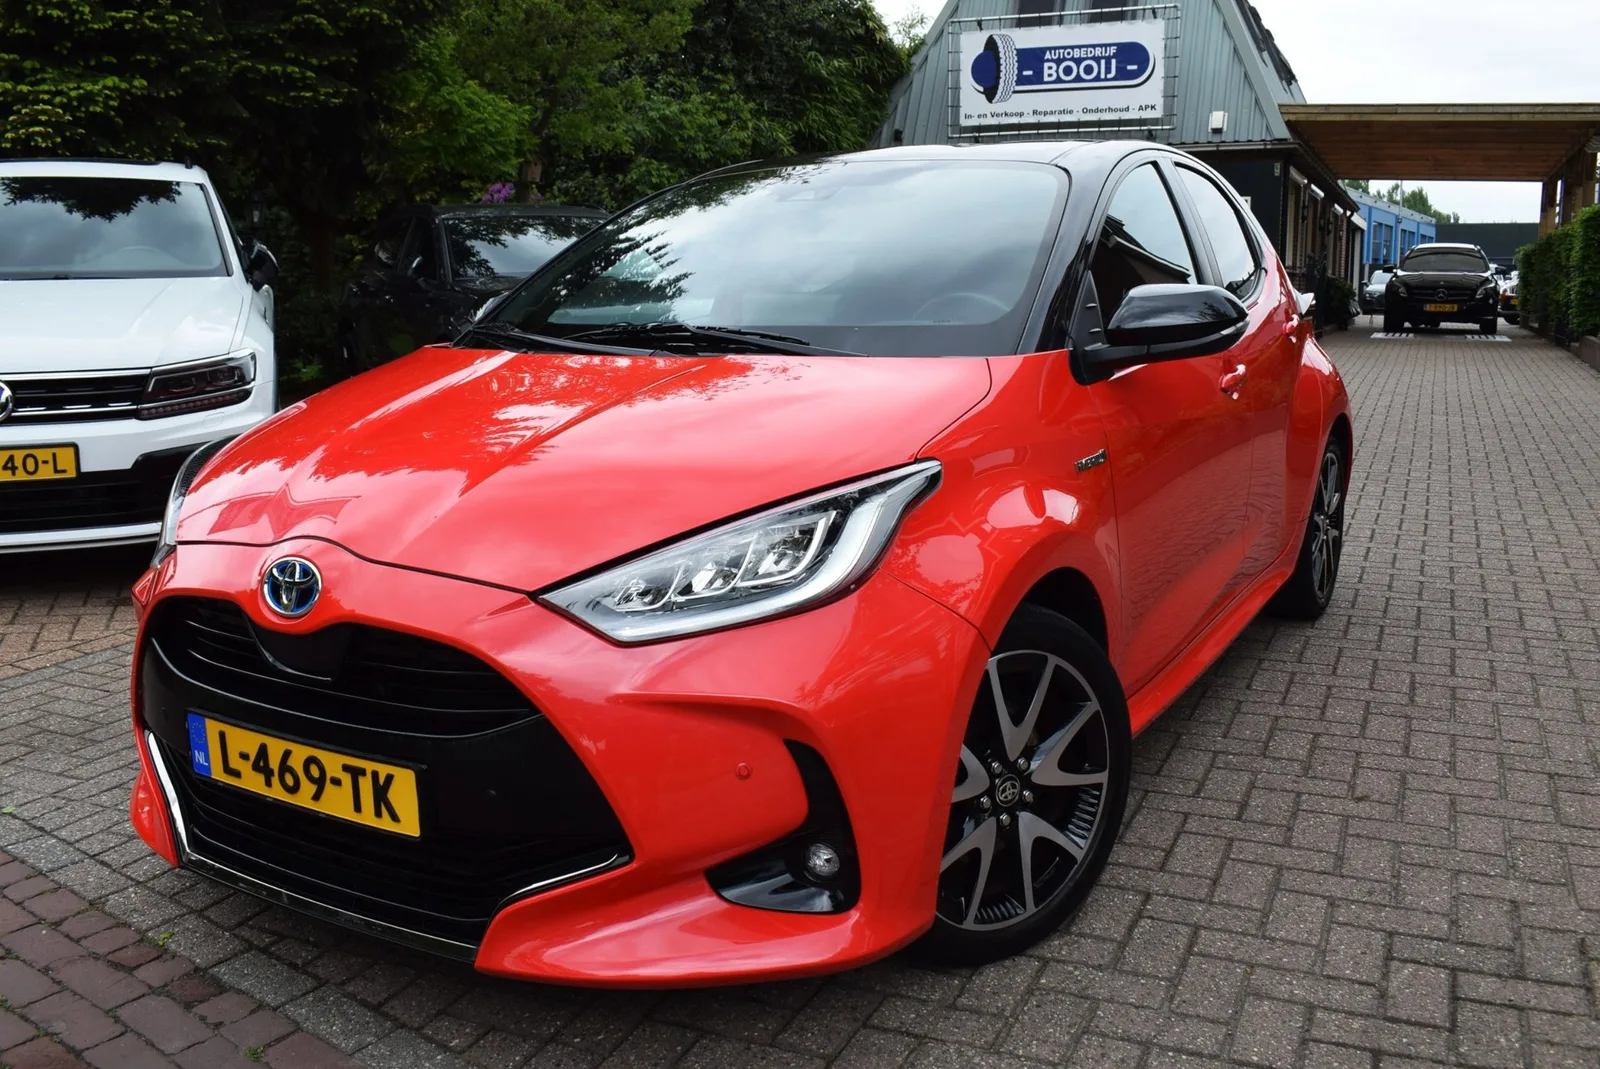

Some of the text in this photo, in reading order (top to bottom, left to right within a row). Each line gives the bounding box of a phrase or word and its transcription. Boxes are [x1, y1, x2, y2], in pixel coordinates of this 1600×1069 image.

[1044, 46, 1117, 60] AUTOBEDRIJF
[1043, 58, 1116, 82] BOOIJ
[964, 112, 975, 120] In-
[990, 110, 1025, 118] Verkoop
[1032, 108, 1074, 117] Reparatie
[1081, 105, 1130, 115] Onderhoud
[1137, 103, 1157, 112] APK
[1, 452, 68, 476] 40-L
[194, 749, 209, 766] NL
[218, 730, 402, 823] L-469-TK
